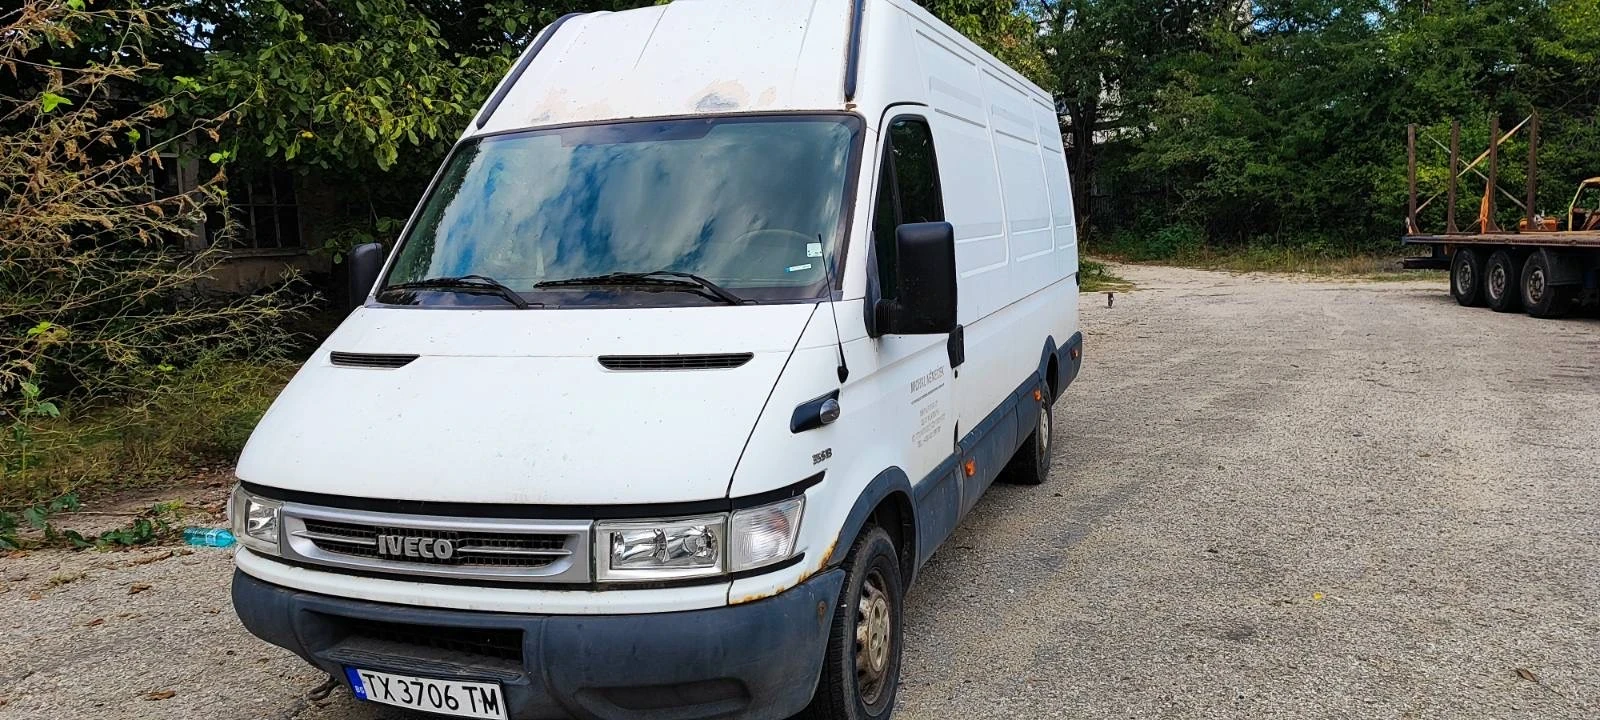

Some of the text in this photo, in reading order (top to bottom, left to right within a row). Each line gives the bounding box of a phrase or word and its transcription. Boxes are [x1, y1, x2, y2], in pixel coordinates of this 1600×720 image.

[378, 534, 453, 559] IVECO
[362, 673, 500, 715] TX 3706 TM
